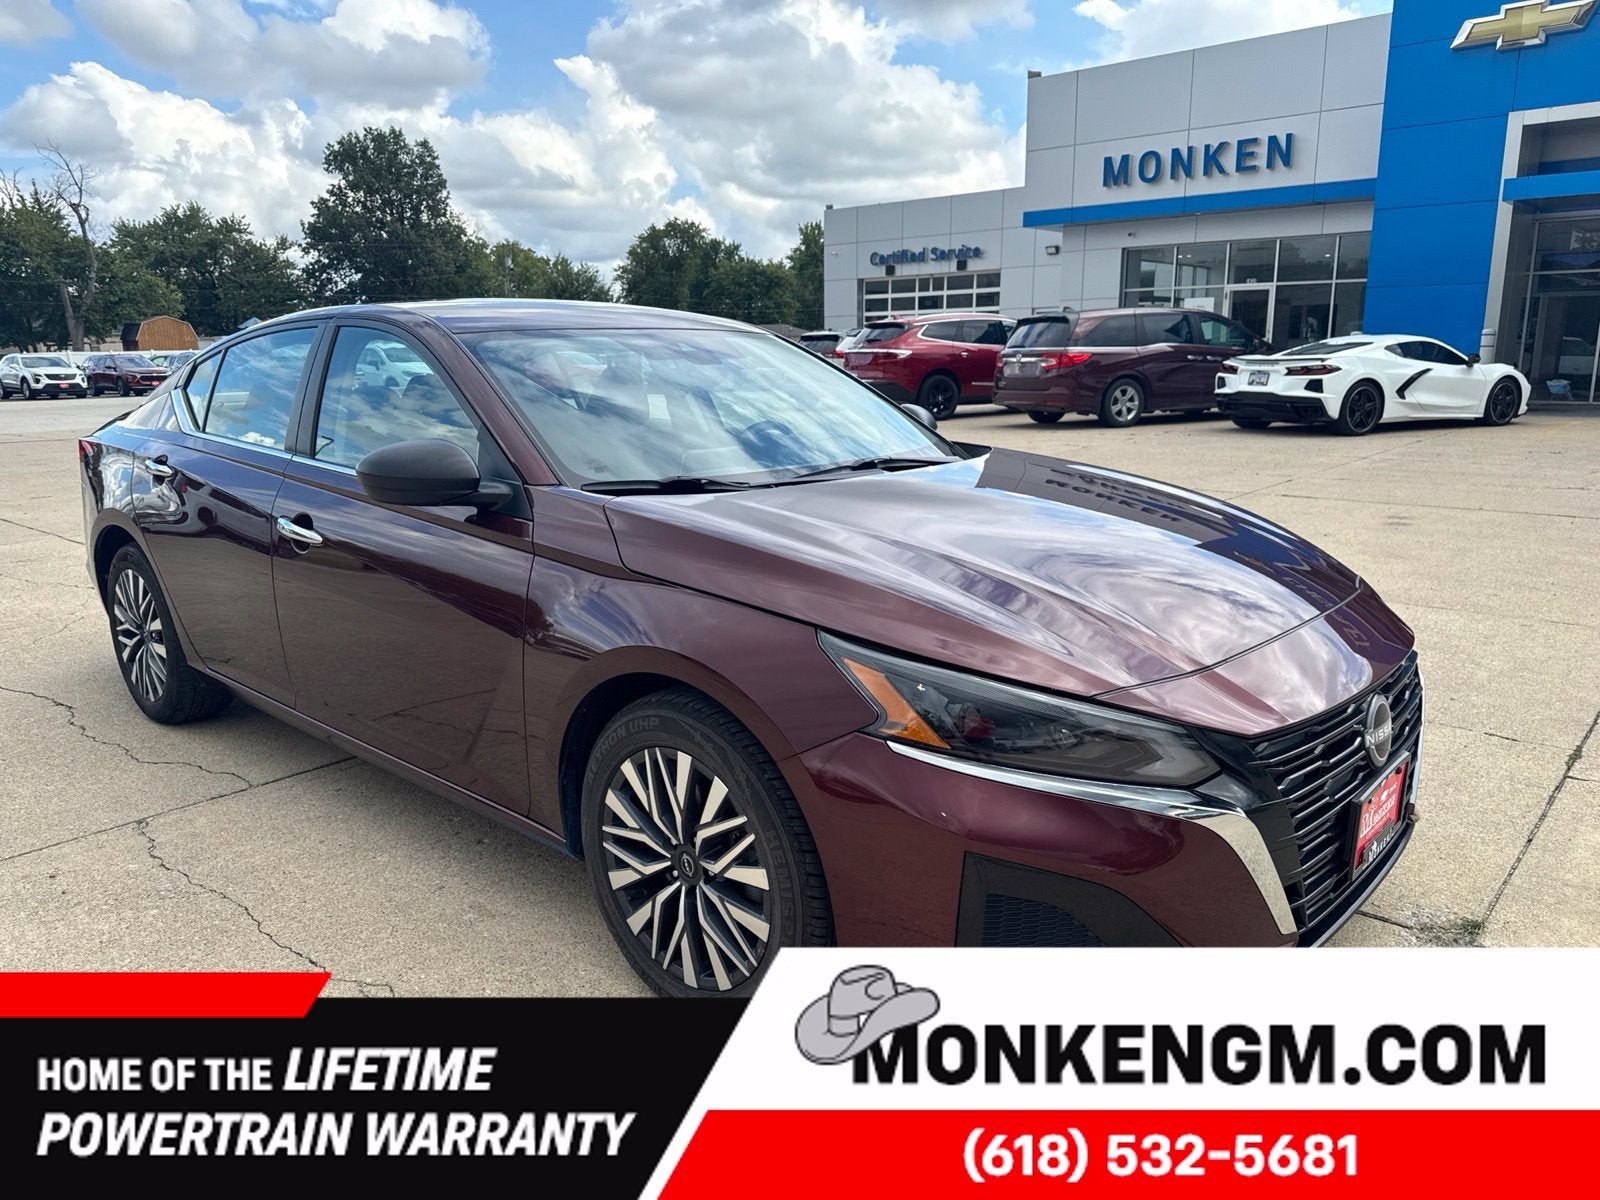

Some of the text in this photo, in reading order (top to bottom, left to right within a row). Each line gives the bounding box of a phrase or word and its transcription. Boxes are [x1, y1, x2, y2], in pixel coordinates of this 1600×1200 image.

[1102, 132, 1296, 188] MONKEN
[870, 244, 982, 266] Certified Service
[629, 716, 660, 733] UHP
[1365, 724, 1391, 748] NISS
